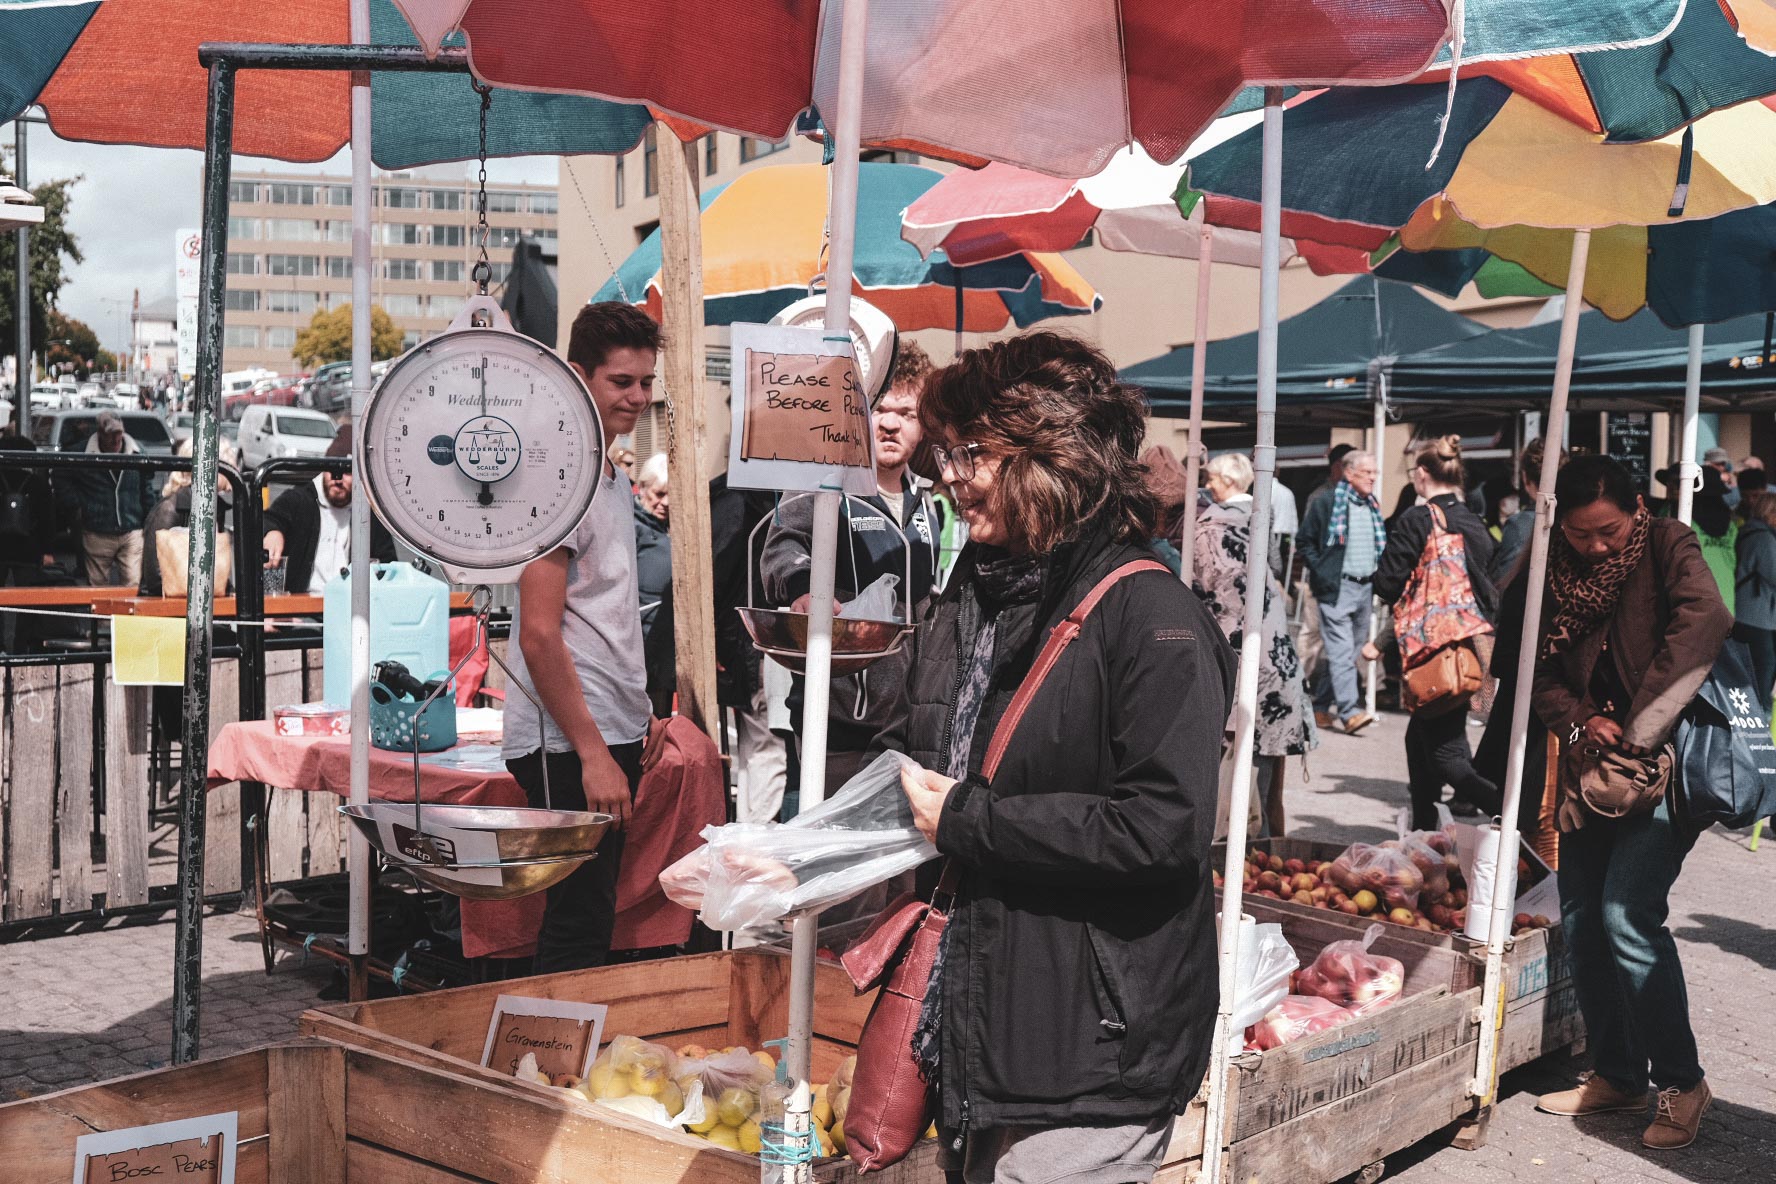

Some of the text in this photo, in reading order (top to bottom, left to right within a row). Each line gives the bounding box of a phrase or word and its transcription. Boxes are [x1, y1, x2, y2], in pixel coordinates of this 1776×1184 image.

[471, 366, 481, 379] 10
[761, 362, 830, 387] PLEASE
[428, 385, 434, 396] 9
[766, 390, 832, 412] BEFORE
[402, 424, 408, 436] 8
[558, 420, 564, 432] 2
[810, 424, 850, 443] Thank
[559, 468, 564, 480] 3
[405, 475, 411, 487] 7
[438, 510, 444, 522] 6
[531, 506, 537, 518] 4
[486, 522, 492, 534] 5
[404, 846, 437, 864] eftp
[506, 1028, 573, 1052] Gravenstein
[108, 1154, 216, 1182] BOSC PEARS
